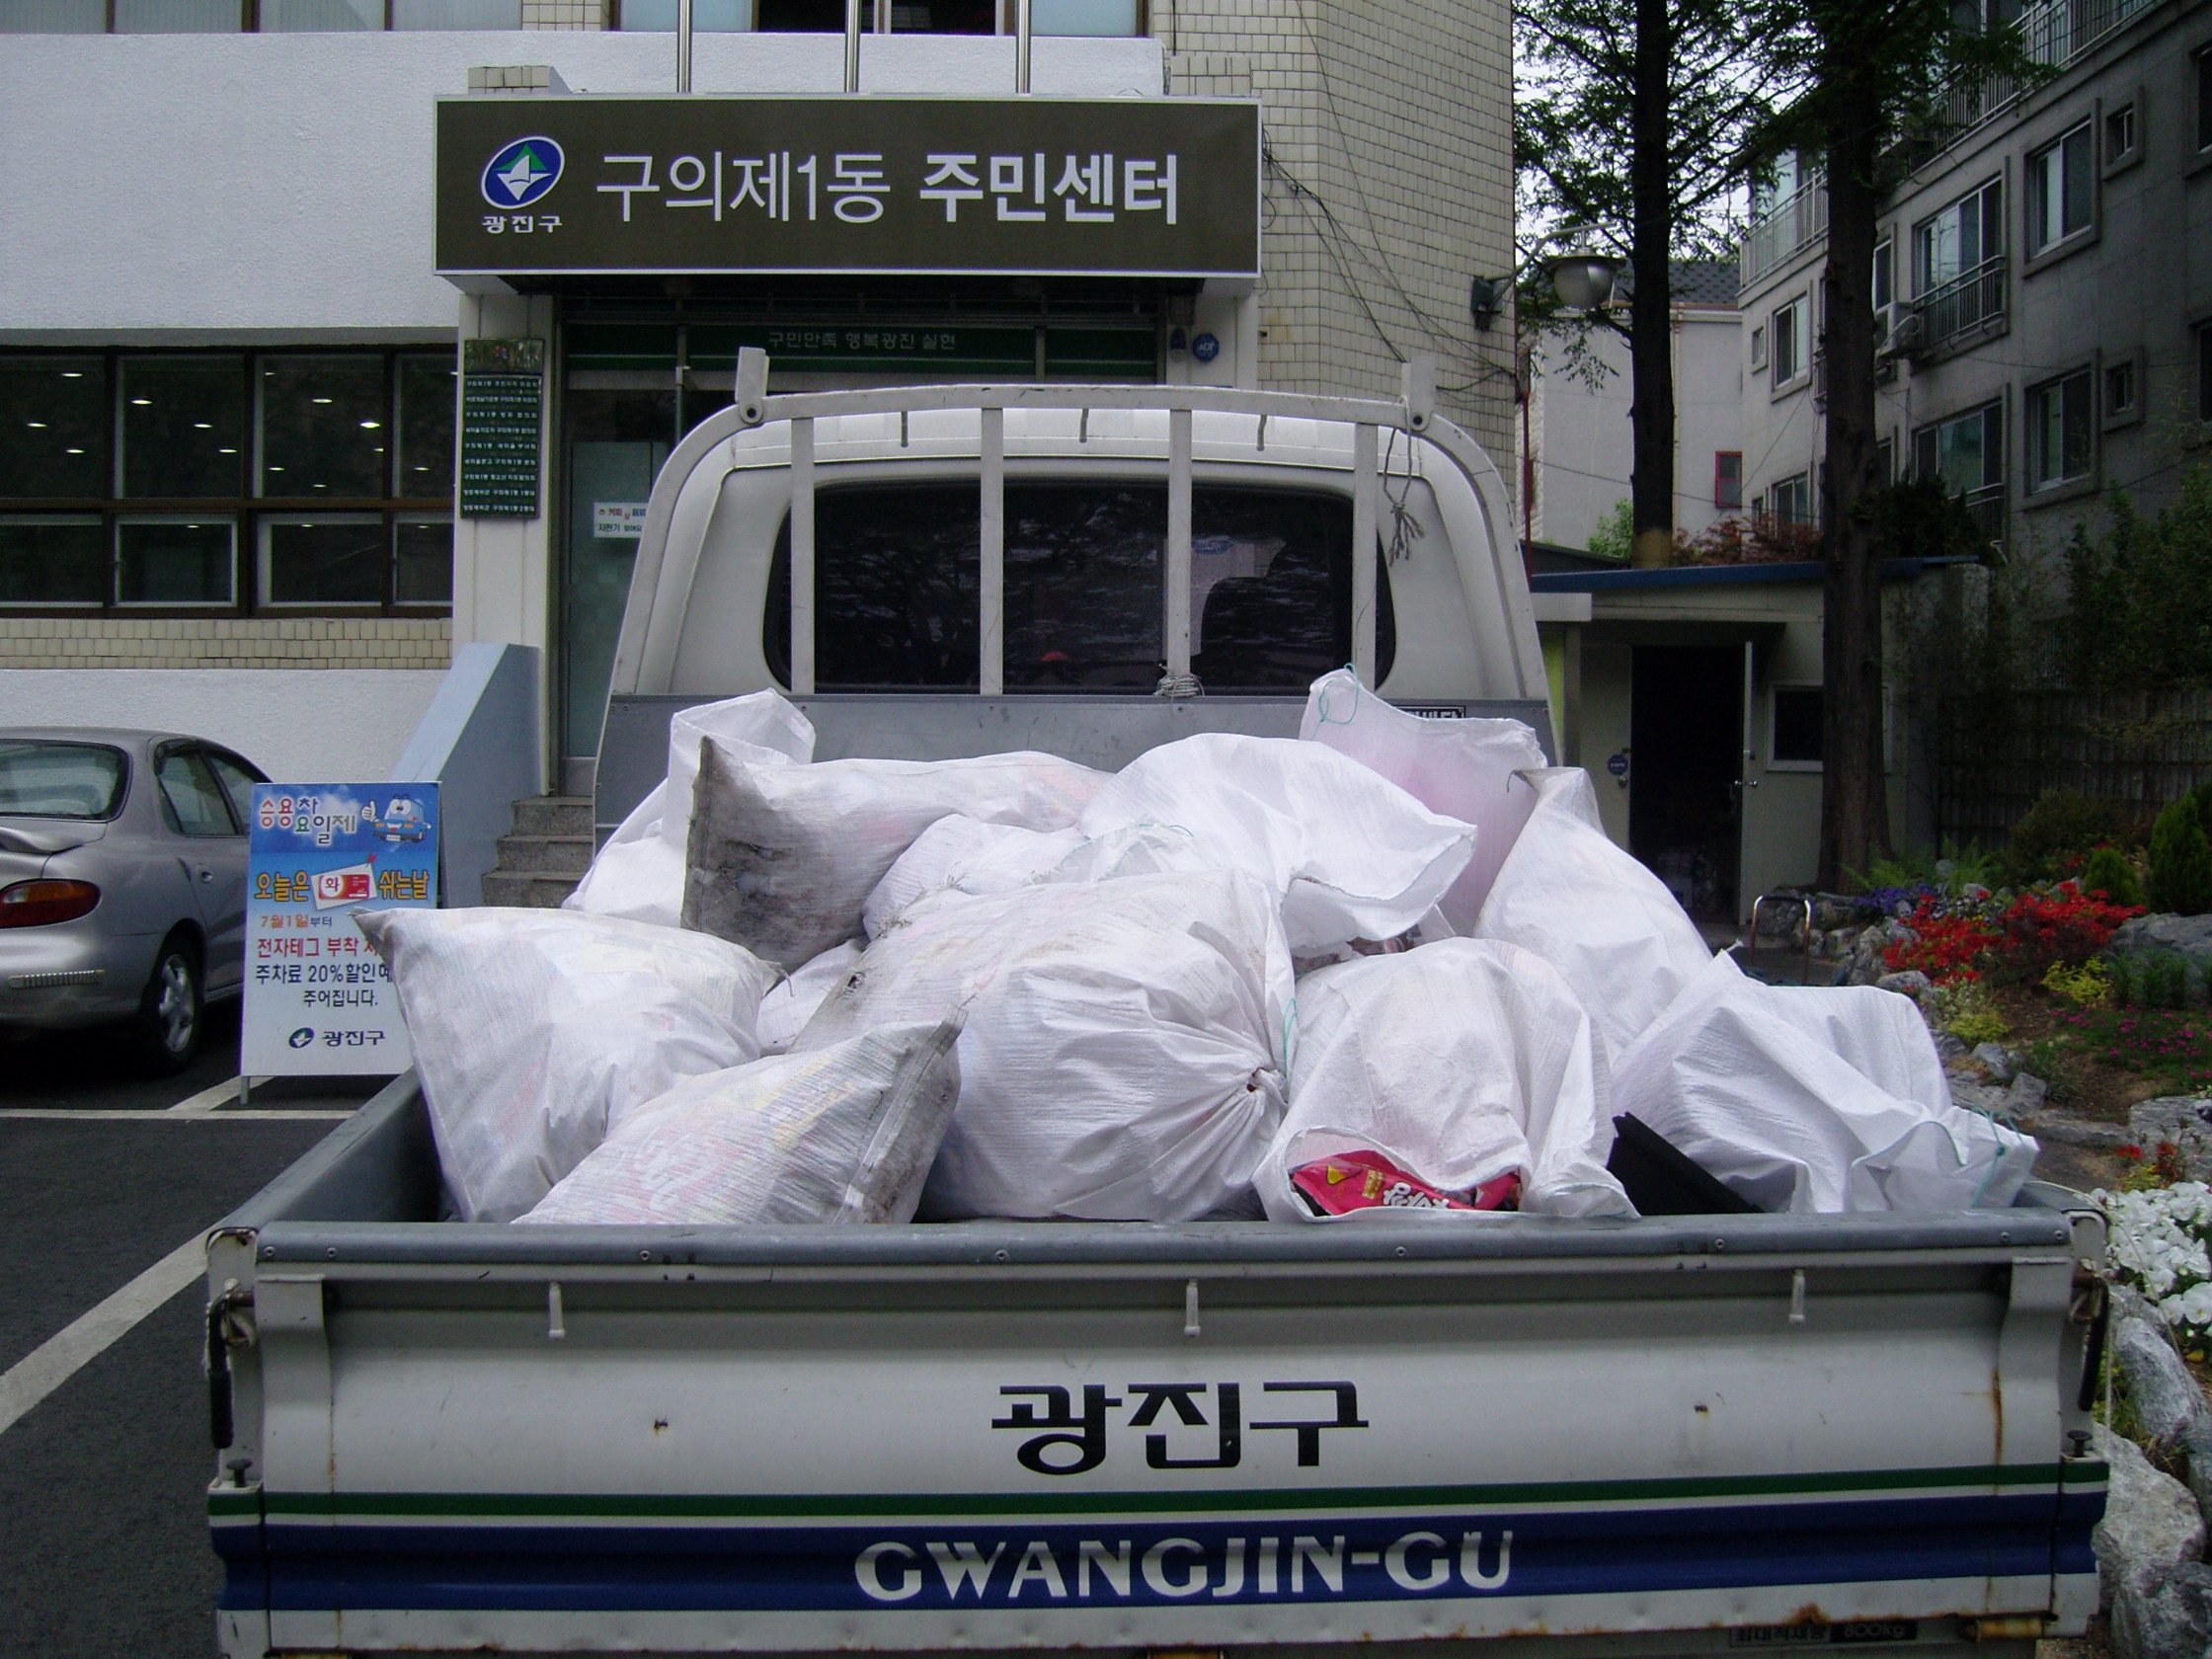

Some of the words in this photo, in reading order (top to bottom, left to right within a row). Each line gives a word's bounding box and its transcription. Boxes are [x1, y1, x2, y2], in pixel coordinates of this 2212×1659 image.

[595, 151, 891, 224] 구의제1동
[919, 152, 1177, 226] 주민센터
[482, 214, 564, 234] 광진구
[768, 332, 837, 349] 구민만족
[845, 332, 914, 351] 행복광진
[922, 334, 956, 351] 실현
[260, 797, 319, 828] 승용차
[294, 815, 356, 845] 요일제
[254, 871, 310, 903] 오늘은
[324, 876, 341, 893] 화
[379, 870, 429, 900] 쉬는날
[257, 936, 320, 958] 전자테그
[327, 936, 359, 958] 부착
[256, 965, 302, 985] 주차료
[303, 988, 378, 1008] 주어집니다.
[321, 1030, 386, 1047] 광진구
[990, 1381, 1370, 1476] 광진구
[853, 1530, 1514, 1602] GWANGJIN-GU
